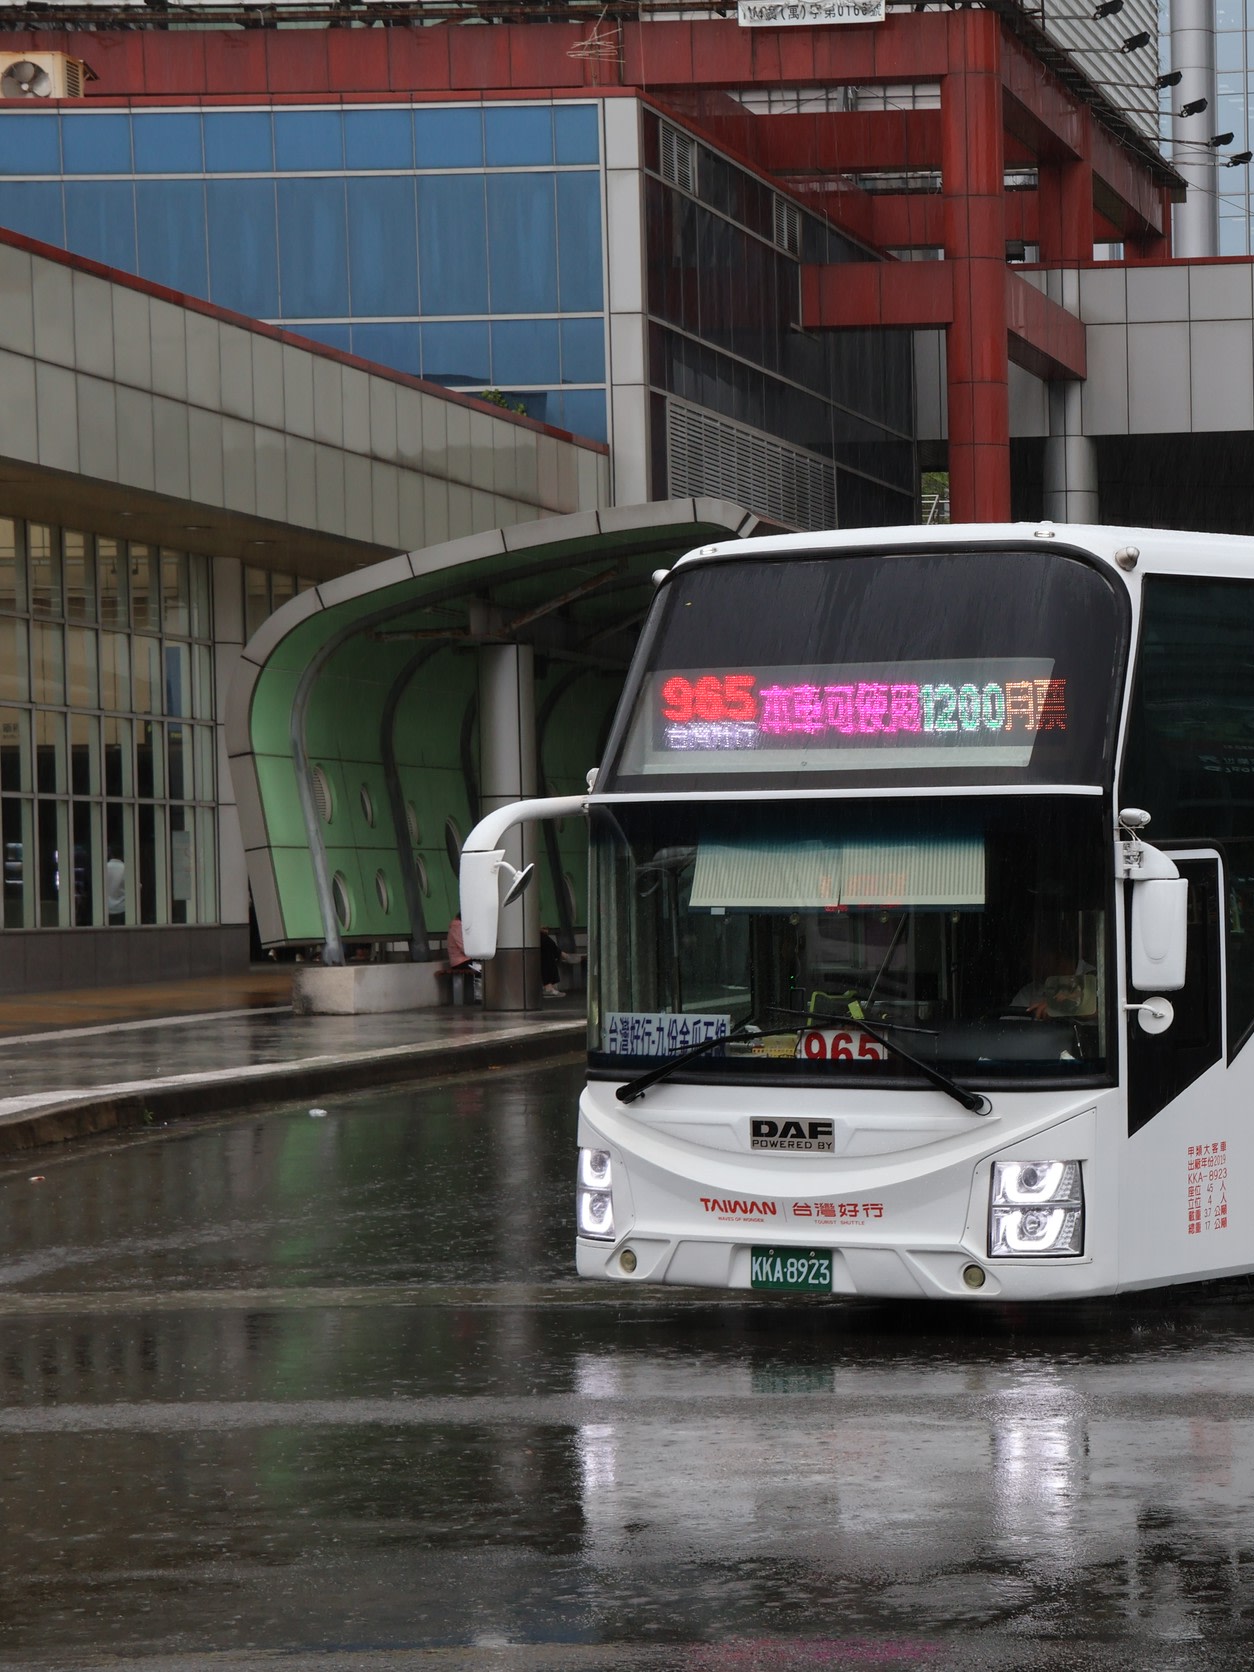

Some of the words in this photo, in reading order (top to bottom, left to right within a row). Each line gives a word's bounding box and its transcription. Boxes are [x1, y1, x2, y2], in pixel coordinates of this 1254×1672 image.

[662, 675, 757, 721] 965
[805, 1032, 880, 1060] 965
[752, 1120, 833, 1139] DAF
[752, 1140, 812, 1149] POWERED
[818, 1142, 832, 1150] BY
[1188, 1168, 1227, 1184] KKA-8923
[1220, 1180, 1226, 1191] 人
[700, 1198, 777, 1215] TAIWAN
[1208, 1195, 1212, 1205] 4
[1220, 1192, 1227, 1204] 人
[792, 1202, 884, 1218] 台灣好行
